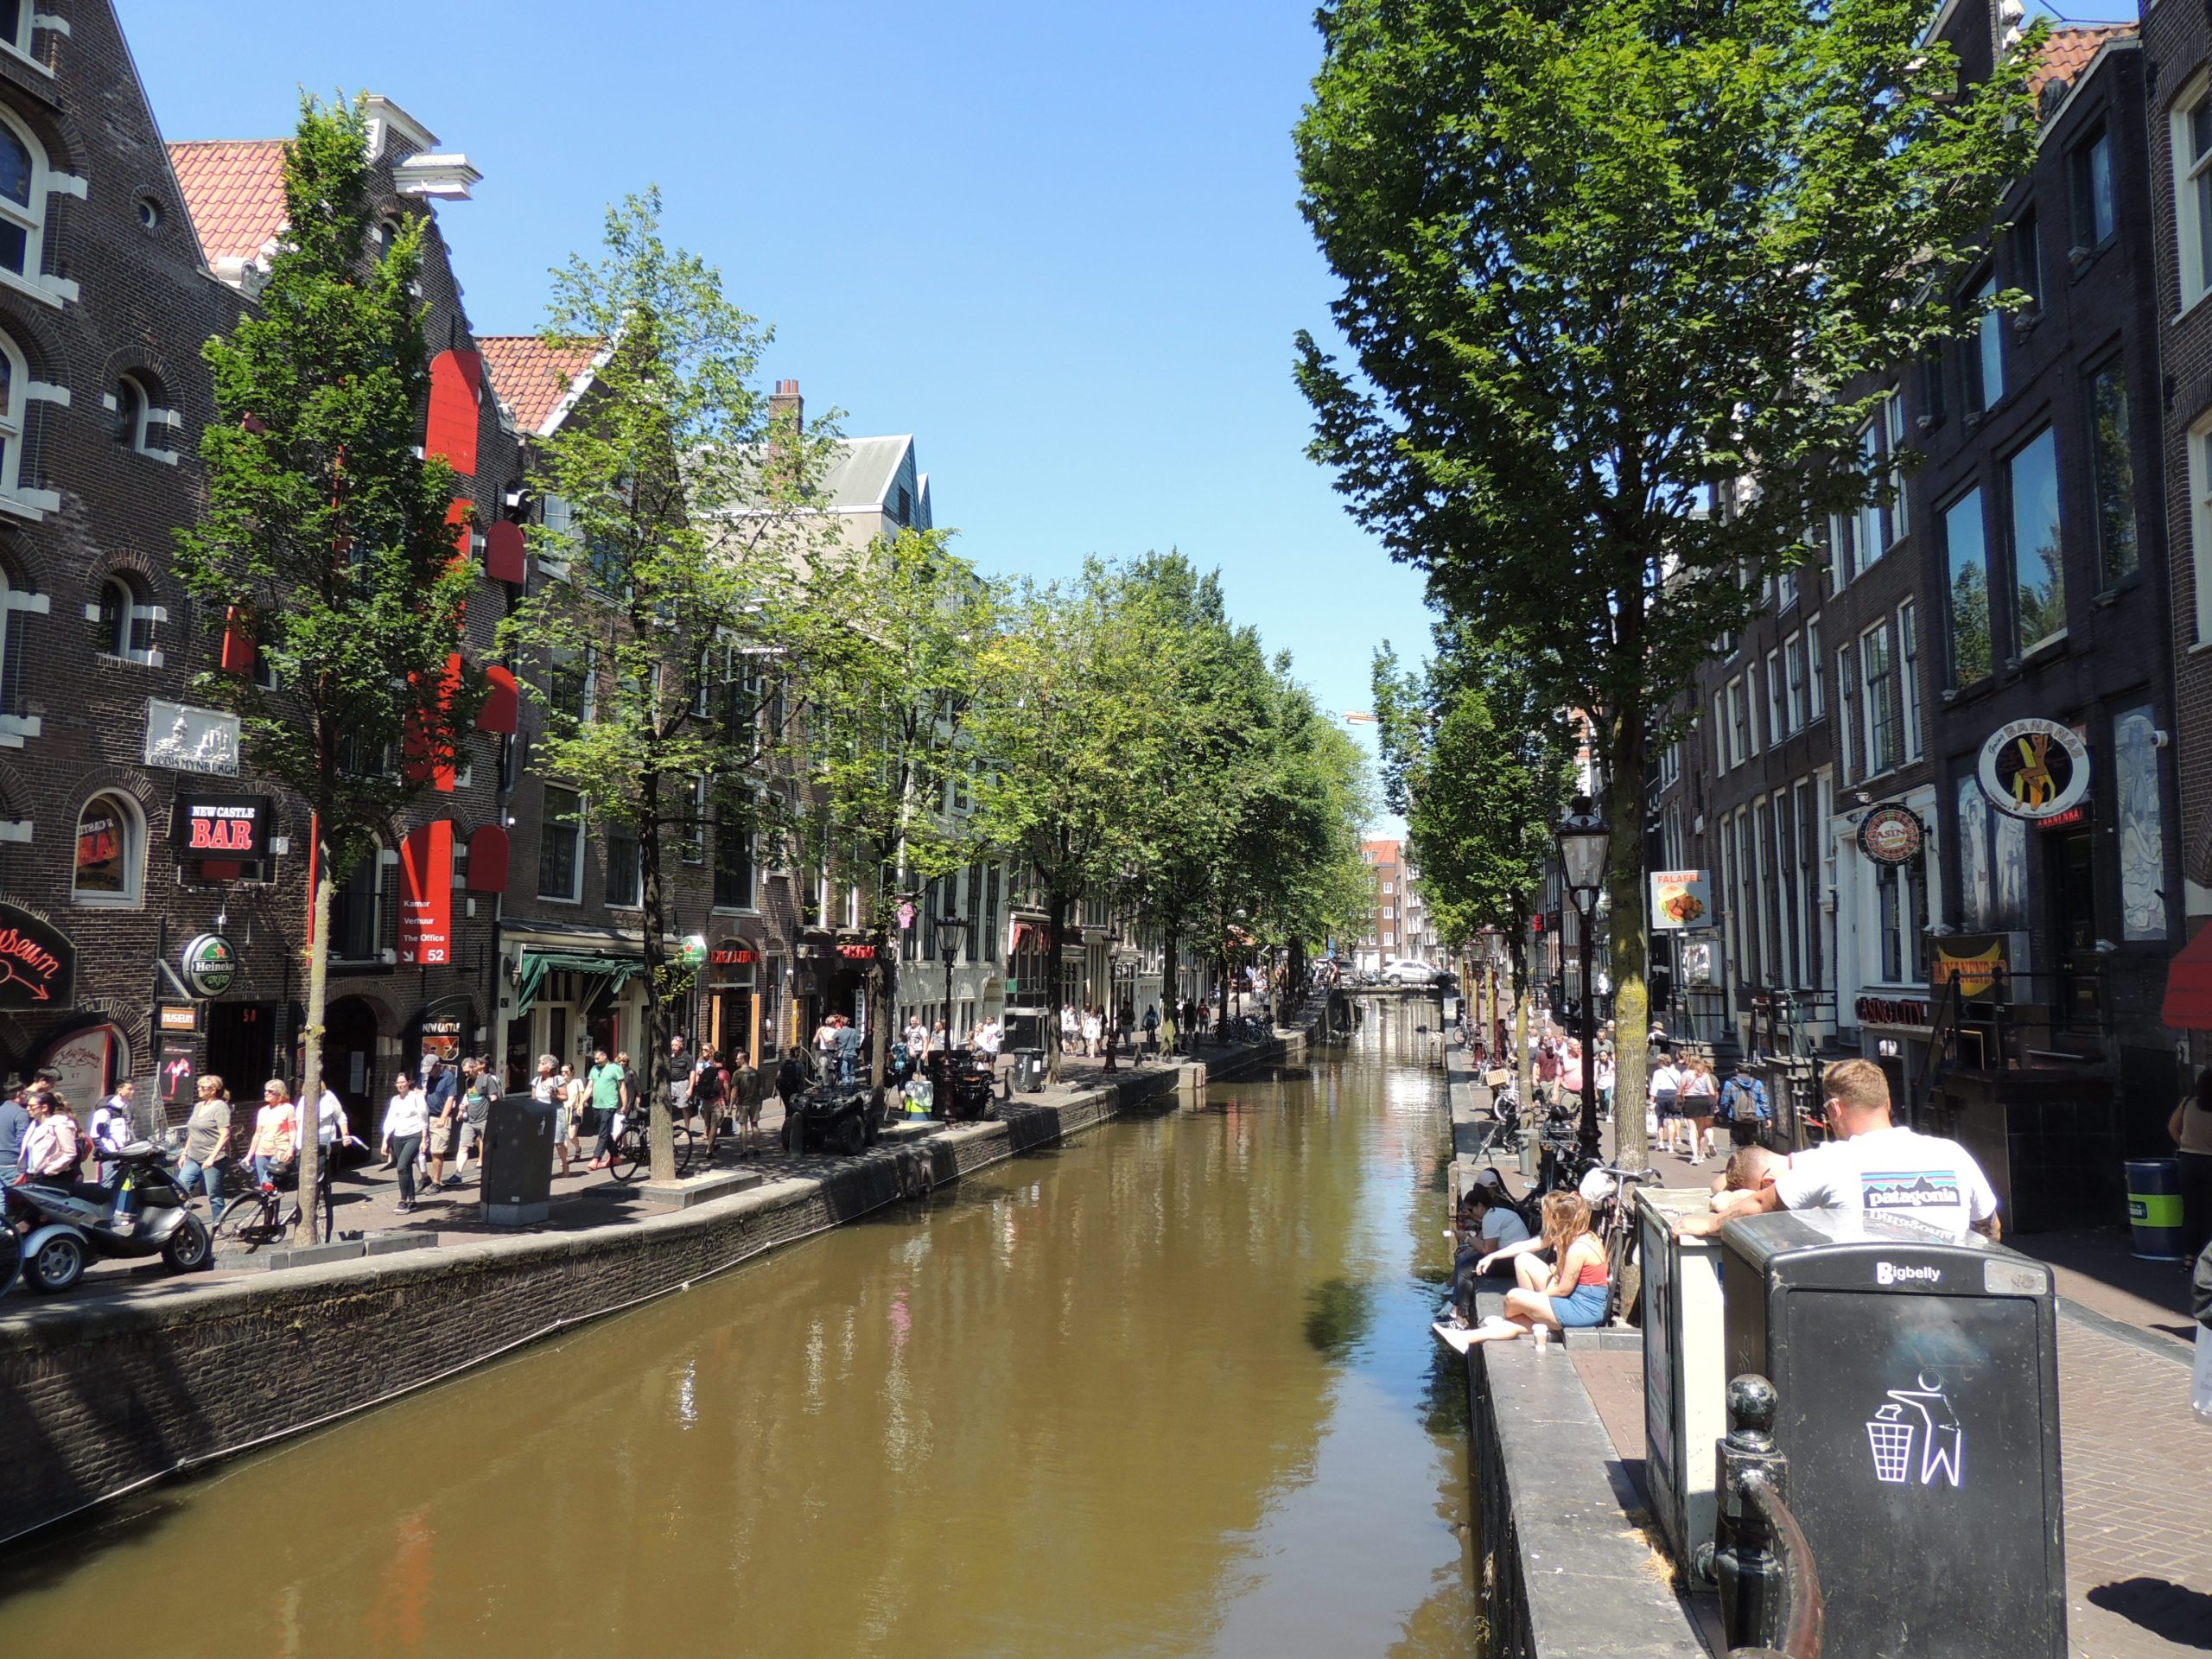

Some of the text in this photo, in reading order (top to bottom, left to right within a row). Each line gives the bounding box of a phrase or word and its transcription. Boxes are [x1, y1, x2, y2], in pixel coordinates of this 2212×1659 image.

[2003, 720, 2084, 760] BANANAS
[192, 805, 255, 818] NEW CASTLE
[189, 818, 252, 850] BAR
[1866, 827, 1917, 842] CASINO
[1657, 874, 1702, 883] FALAFEL
[420, 933, 445, 942] Office
[427, 949, 444, 962] 52
[162, 1013, 194, 1024] MUSEUM
[1855, 998, 1922, 1026] CASINO CITY
[423, 1023, 461, 1033] NEW CASTLE
[1869, 1188, 1958, 1207] patagonia
[1877, 1262, 1941, 1285] Bigbelly
